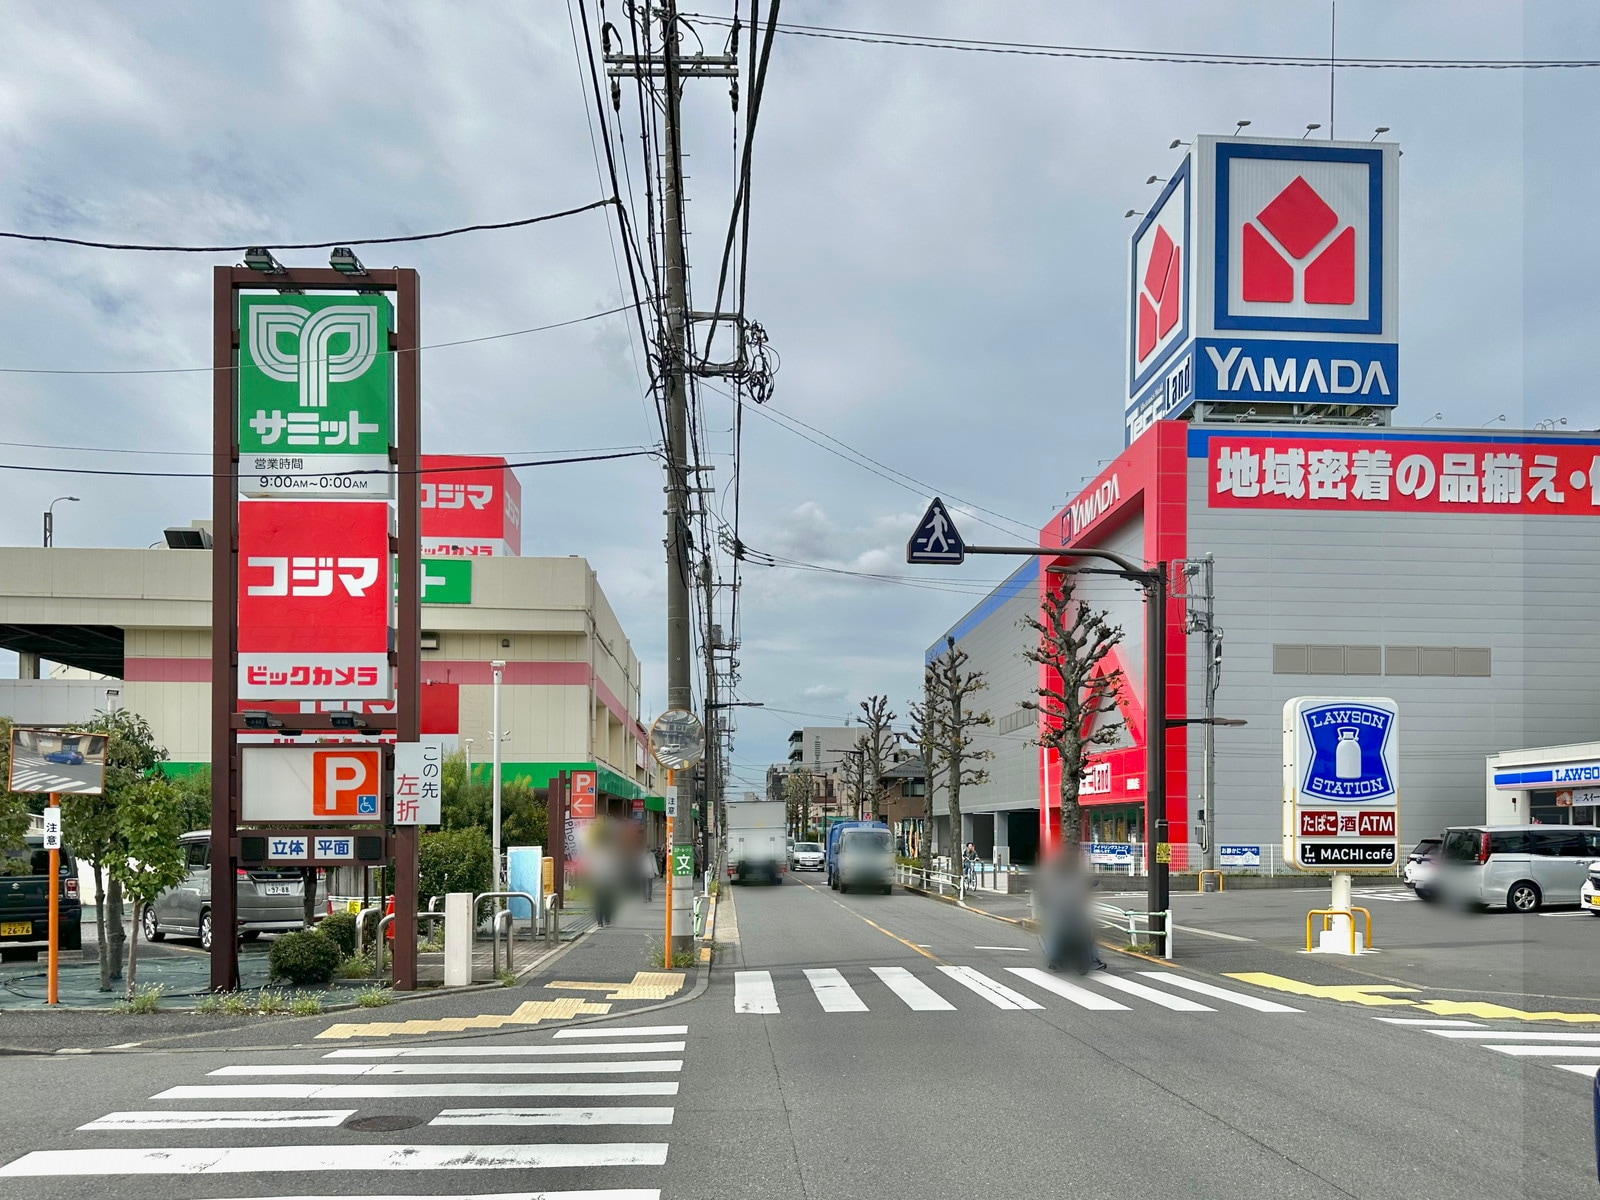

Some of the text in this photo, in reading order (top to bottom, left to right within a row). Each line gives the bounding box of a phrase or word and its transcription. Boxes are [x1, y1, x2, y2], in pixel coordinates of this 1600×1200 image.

[1205, 347, 1391, 395] YAMADA
[250, 410, 379, 445] サミット
[255, 458, 303, 470] 営業時間
[420, 483, 493, 510] コジマ
[1071, 473, 1120, 536] YAMADA
[247, 556, 379, 597] コジマ
[247, 666, 378, 686] ビックカメラ
[1310, 710, 1386, 729] LAWSON
[421, 746, 439, 799] この先
[325, 756, 367, 811] P
[576, 774, 591, 793] P
[1311, 776, 1385, 795] STATION
[396, 773, 420, 822] 左折
[667, 797, 676, 815] 注意
[1303, 814, 1394, 832] たばこ 酒 ATM
[46, 822, 58, 846] 注意
[272, 840, 305, 856] 立体
[317, 840, 350, 856] 平面
[1321, 848, 1364, 860] MACHI
[1366, 848, 1393, 860] café
[676, 854, 691, 871] 文
